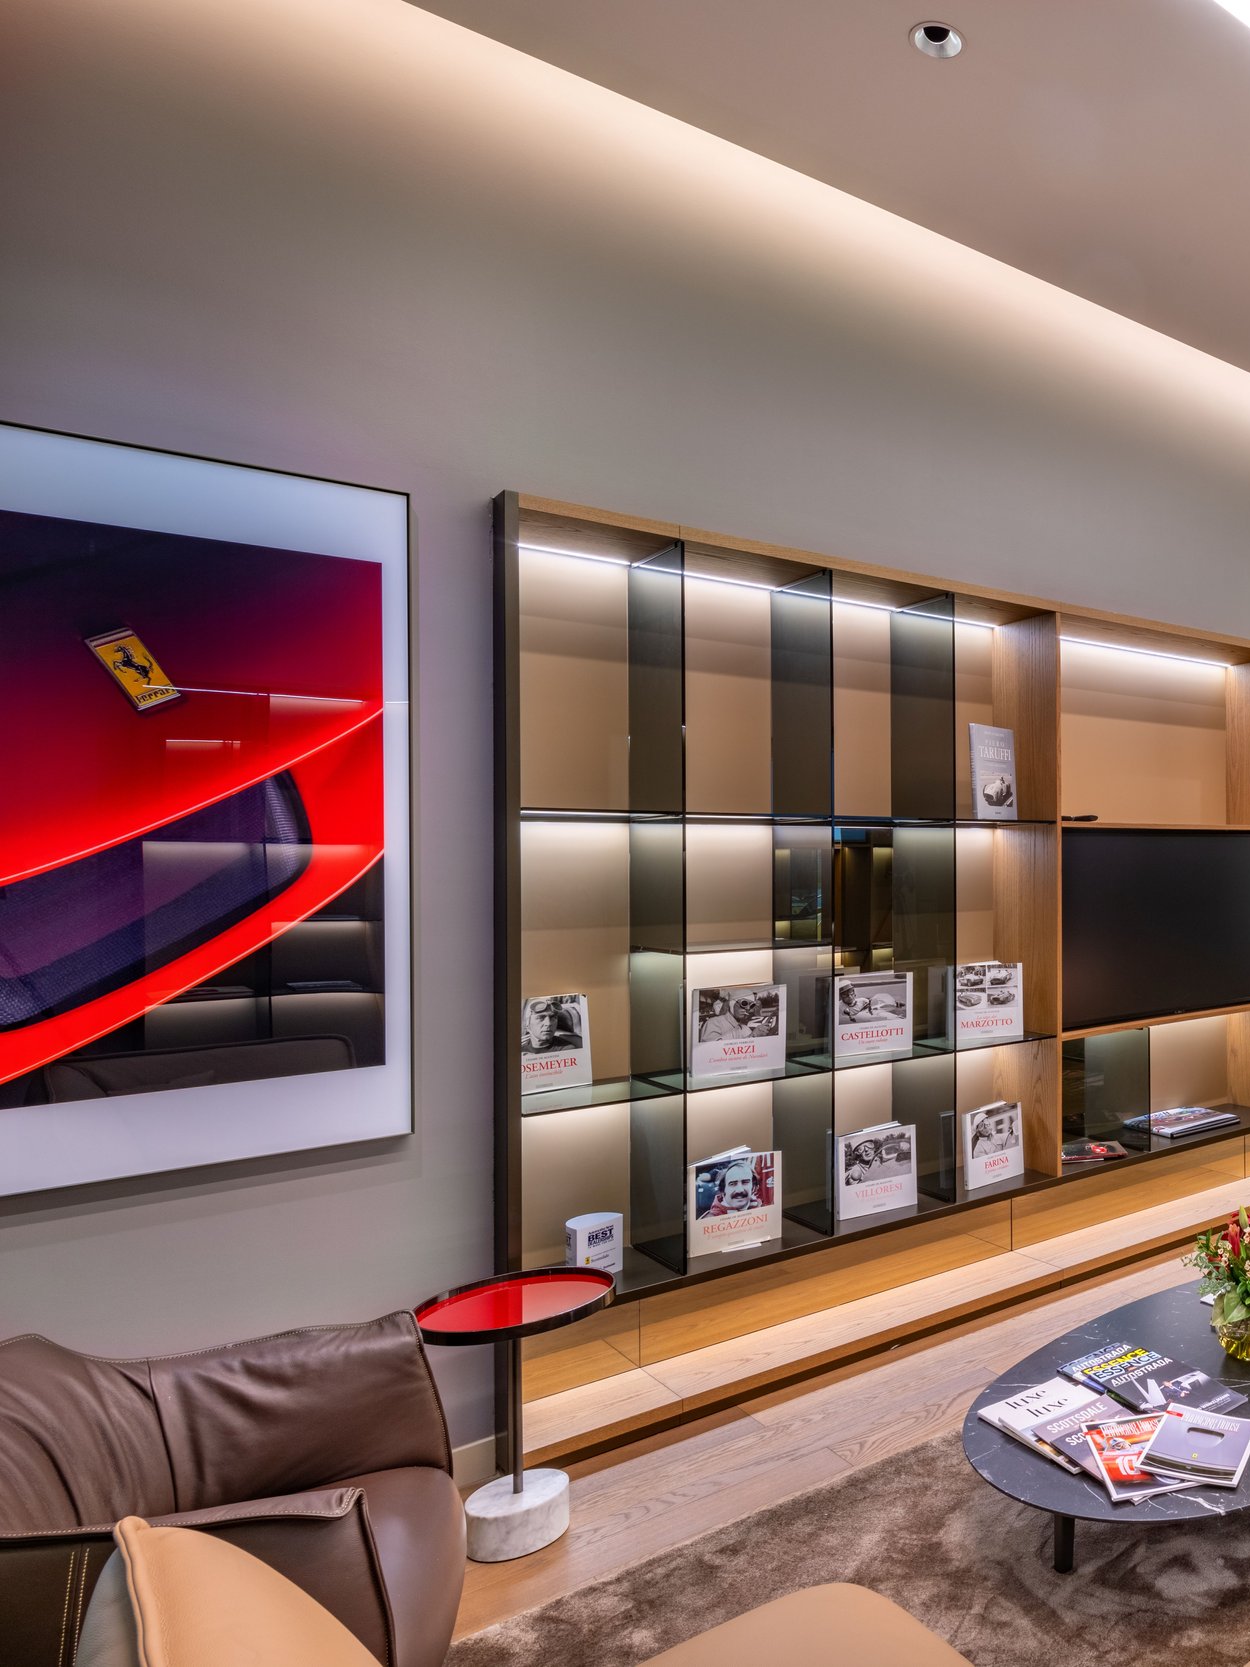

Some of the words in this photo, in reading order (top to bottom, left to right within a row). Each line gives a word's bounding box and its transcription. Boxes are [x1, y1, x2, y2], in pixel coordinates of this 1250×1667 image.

[978, 745, 1011, 761] TARUFFI
[960, 1017, 1014, 1029] MARZOTTO
[841, 1027, 904, 1041] CASTELLOTTI
[722, 1044, 756, 1056] VARZI
[984, 1155, 1009, 1170] FARINA
[855, 1182, 904, 1199] VILLORESI
[703, 1213, 769, 1236] REGAZZONI
[588, 1227, 614, 1242] BEST
[1072, 1343, 1132, 1373] AUTOSTRADA
[1083, 1348, 1149, 1375] ESSENCE
[1094, 1352, 1161, 1380] ESSENCE
[1111, 1357, 1174, 1388] AUTOSTRADA
[1046, 1402, 1108, 1434] SCOTTSDALE
